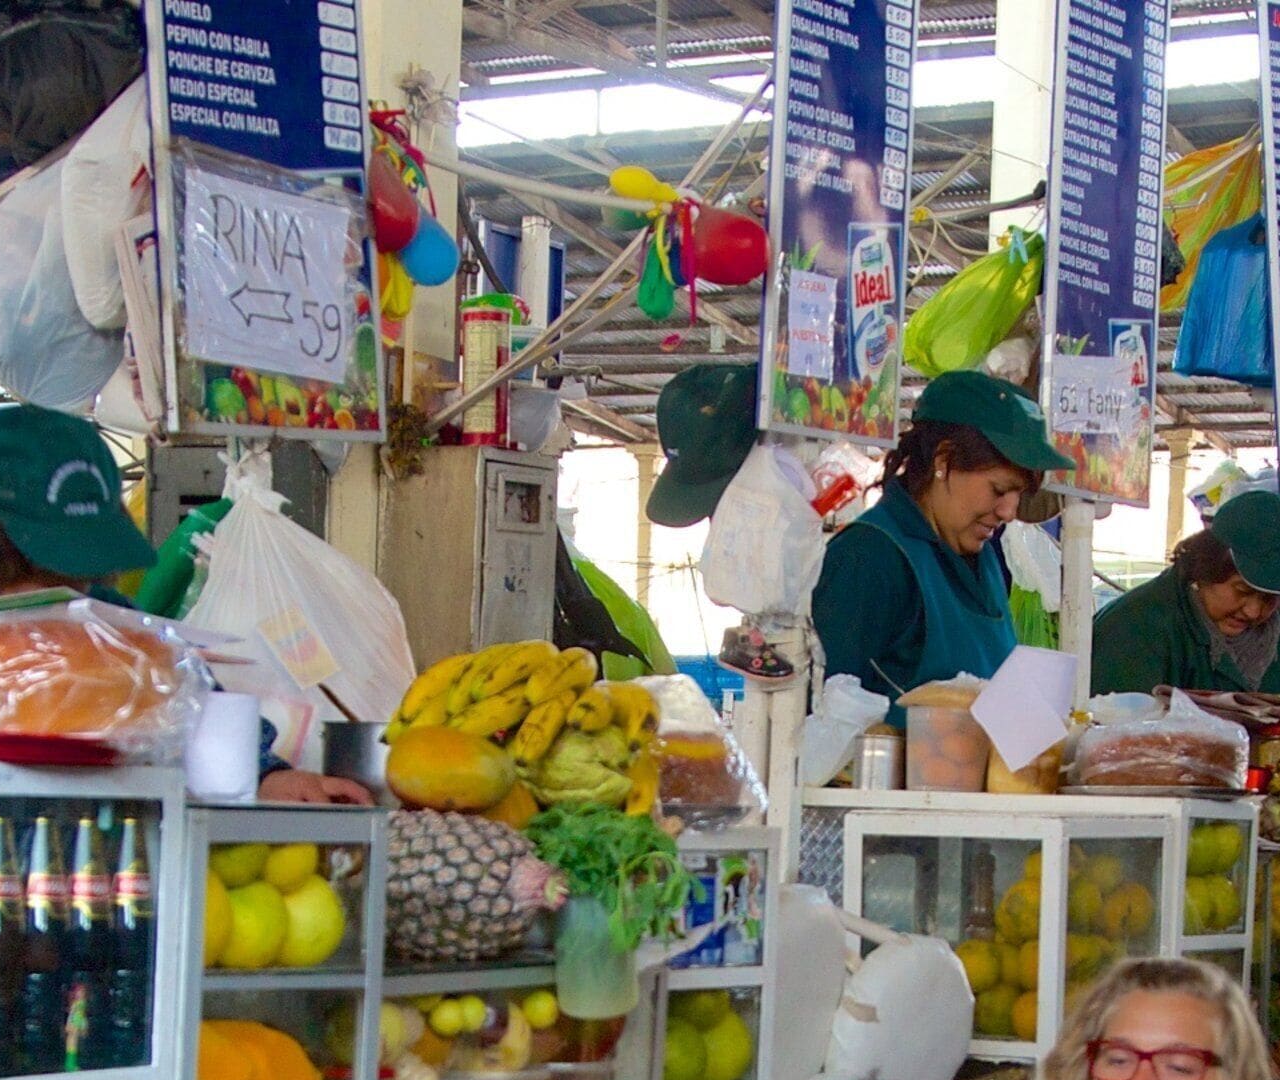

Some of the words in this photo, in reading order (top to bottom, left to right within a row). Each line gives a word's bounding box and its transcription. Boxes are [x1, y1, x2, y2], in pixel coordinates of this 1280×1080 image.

[165, 0, 212, 22] POMELO
[167, 24, 207, 47] PEPINO
[209, 31, 232, 51] CON
[233, 35, 271, 58] SABILA
[792, 13, 825, 35] ENSALADA
[826, 25, 837, 38] DE
[837, 28, 860, 50] FRUTAS
[168, 50, 214, 73] PONCHE
[215, 59, 229, 77] DE
[230, 62, 276, 85] CERVEZA
[169, 76, 205, 98] MEDIO
[207, 83, 258, 107] ESPECIAL
[789, 77, 819, 99] POMELO
[170, 102, 221, 126] ESPECIAL
[222, 111, 245, 130] CON
[246, 114, 281, 137] MALTA
[788, 99, 815, 121] PEPINO
[815, 108, 831, 124] CON
[831, 111, 854, 131] SABILA
[787, 120, 817, 141] PONCHE
[817, 128, 826, 143] DE
[827, 131, 856, 151] CERVEZA
[210, 193, 310, 286] RINA
[854, 265, 891, 308] Ideal
[299, 299, 343, 363] 59
[1060, 386, 1078, 413] 61
[1088, 387, 1122, 421] Fany
